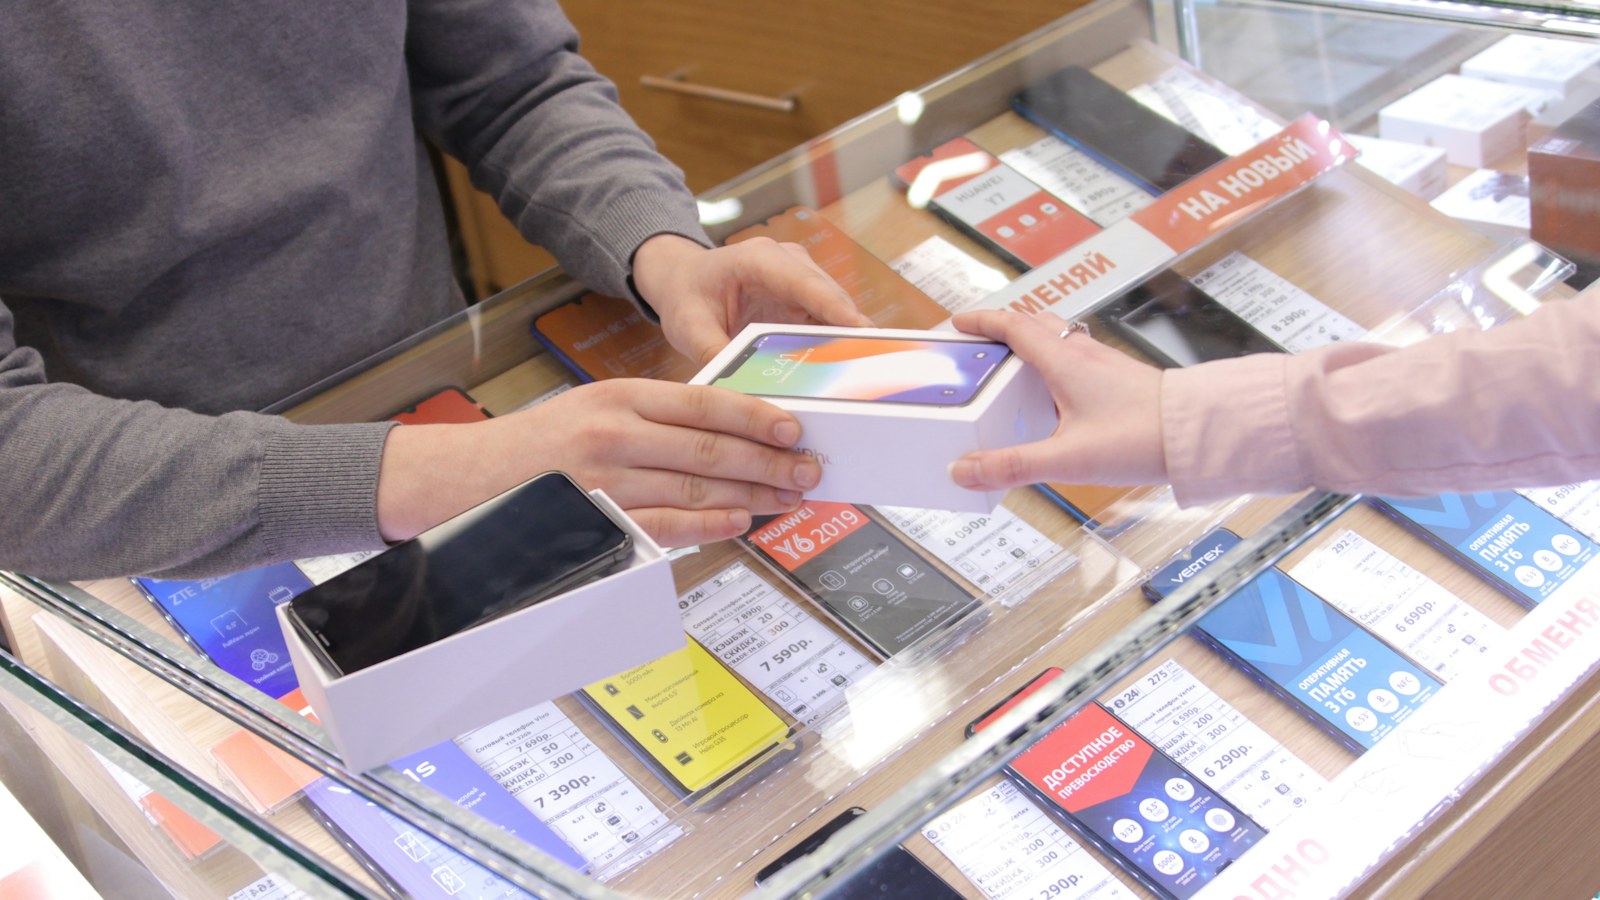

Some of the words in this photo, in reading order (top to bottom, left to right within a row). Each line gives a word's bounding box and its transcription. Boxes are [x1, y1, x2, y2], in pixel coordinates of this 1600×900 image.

[955, 175, 1005, 203] HUAWEI
[1178, 190, 1227, 222] НА
[1227, 135, 1317, 199] НОВЫЙ
[985, 192, 1007, 207] Y7
[1000, 249, 1118, 317] МЕНЯЙ
[1547, 496, 1558, 506] 6
[758, 506, 815, 545] HUAWEI
[773, 532, 815, 560] Y6
[809, 510, 859, 544] 2019
[944, 536, 956, 547] 8
[955, 514, 991, 540] 090р.
[1469, 513, 1515, 551] ОПЕРАТИВНАЯ
[1331, 538, 1351, 555] 292
[1479, 521, 1531, 562] ПАМЯТЬ
[1170, 544, 1224, 583] VERTEX
[1494, 559, 1510, 572] 3
[1502, 547, 1523, 565] Гб
[168, 586, 198, 607] ZTE
[688, 590, 704, 606] 24
[692, 611, 718, 631] Сотовый
[717, 597, 742, 616] телефон
[741, 583, 763, 600] Realme
[734, 615, 741, 624] 7
[741, 604, 765, 621] 890р.
[758, 612, 774, 625] 20
[1395, 622, 1406, 633] 6
[1403, 599, 1437, 627] 690р.
[713, 628, 750, 654] КЭШБЭК
[767, 620, 789, 637] 300
[723, 636, 759, 662] СКИДКА
[759, 661, 772, 673] 7
[772, 638, 813, 666] 590р.
[1488, 592, 1600, 697] ОБМЕНЯ
[1298, 648, 1351, 691] ОПЕРАТИВНАЯ
[1308, 657, 1368, 703] ПАМЯТЬ
[1124, 688, 1139, 701] 24
[1147, 669, 1169, 687] 275
[1396, 676, 1414, 690] NFC
[1155, 696, 1178, 715] телефон
[1177, 683, 1197, 700] Vertex
[1324, 700, 1341, 714] 3
[1333, 687, 1357, 706] Гб
[1376, 694, 1385, 704] 8
[669, 710, 696, 728] Двойная
[694, 696, 717, 714] камера
[1172, 718, 1179, 726] 6
[1179, 706, 1202, 723] 590р.
[1192, 713, 1214, 729] 200
[475, 735, 506, 754] Сотовый
[506, 721, 535, 738] телефон
[534, 711, 550, 723] Vivo
[515, 745, 524, 754] 7
[525, 732, 552, 750] 690р.
[692, 731, 717, 750] Игровой
[715, 713, 749, 736] процессор
[1161, 730, 1188, 752] ЭШБЭК
[1206, 723, 1228, 741] 300
[541, 742, 559, 756] 50
[549, 751, 575, 770] 300
[698, 743, 715, 756] Helio
[1042, 725, 1124, 791] ДОСТУПНОЕ
[1172, 739, 1198, 761] КИДКА
[1203, 767, 1215, 779] 6
[1213, 743, 1253, 771] 290р.
[402, 760, 438, 783] 1s
[493, 758, 530, 781] ЭШБЭК
[502, 768, 538, 790] КИДКА
[1057, 738, 1136, 800] ПРЕВОСХОДСТВО
[509, 780, 534, 796] ADE-IN
[535, 773, 546, 785] ДО
[533, 796, 545, 809] 7
[548, 773, 597, 802] 390р.
[1171, 781, 1185, 793] 16
[1119, 823, 1138, 839] 3/32
[1188, 835, 1198, 845] 8
[1022, 838, 1045, 856] 200
[1035, 850, 1059, 869] 300
[976, 857, 1015, 884] КЭШБЭК
[1157, 852, 1177, 870] 5000
[1232, 838, 1330, 900] ДНО
[988, 868, 1025, 893] СКИДКА
[1040, 873, 1084, 900] 290р.
